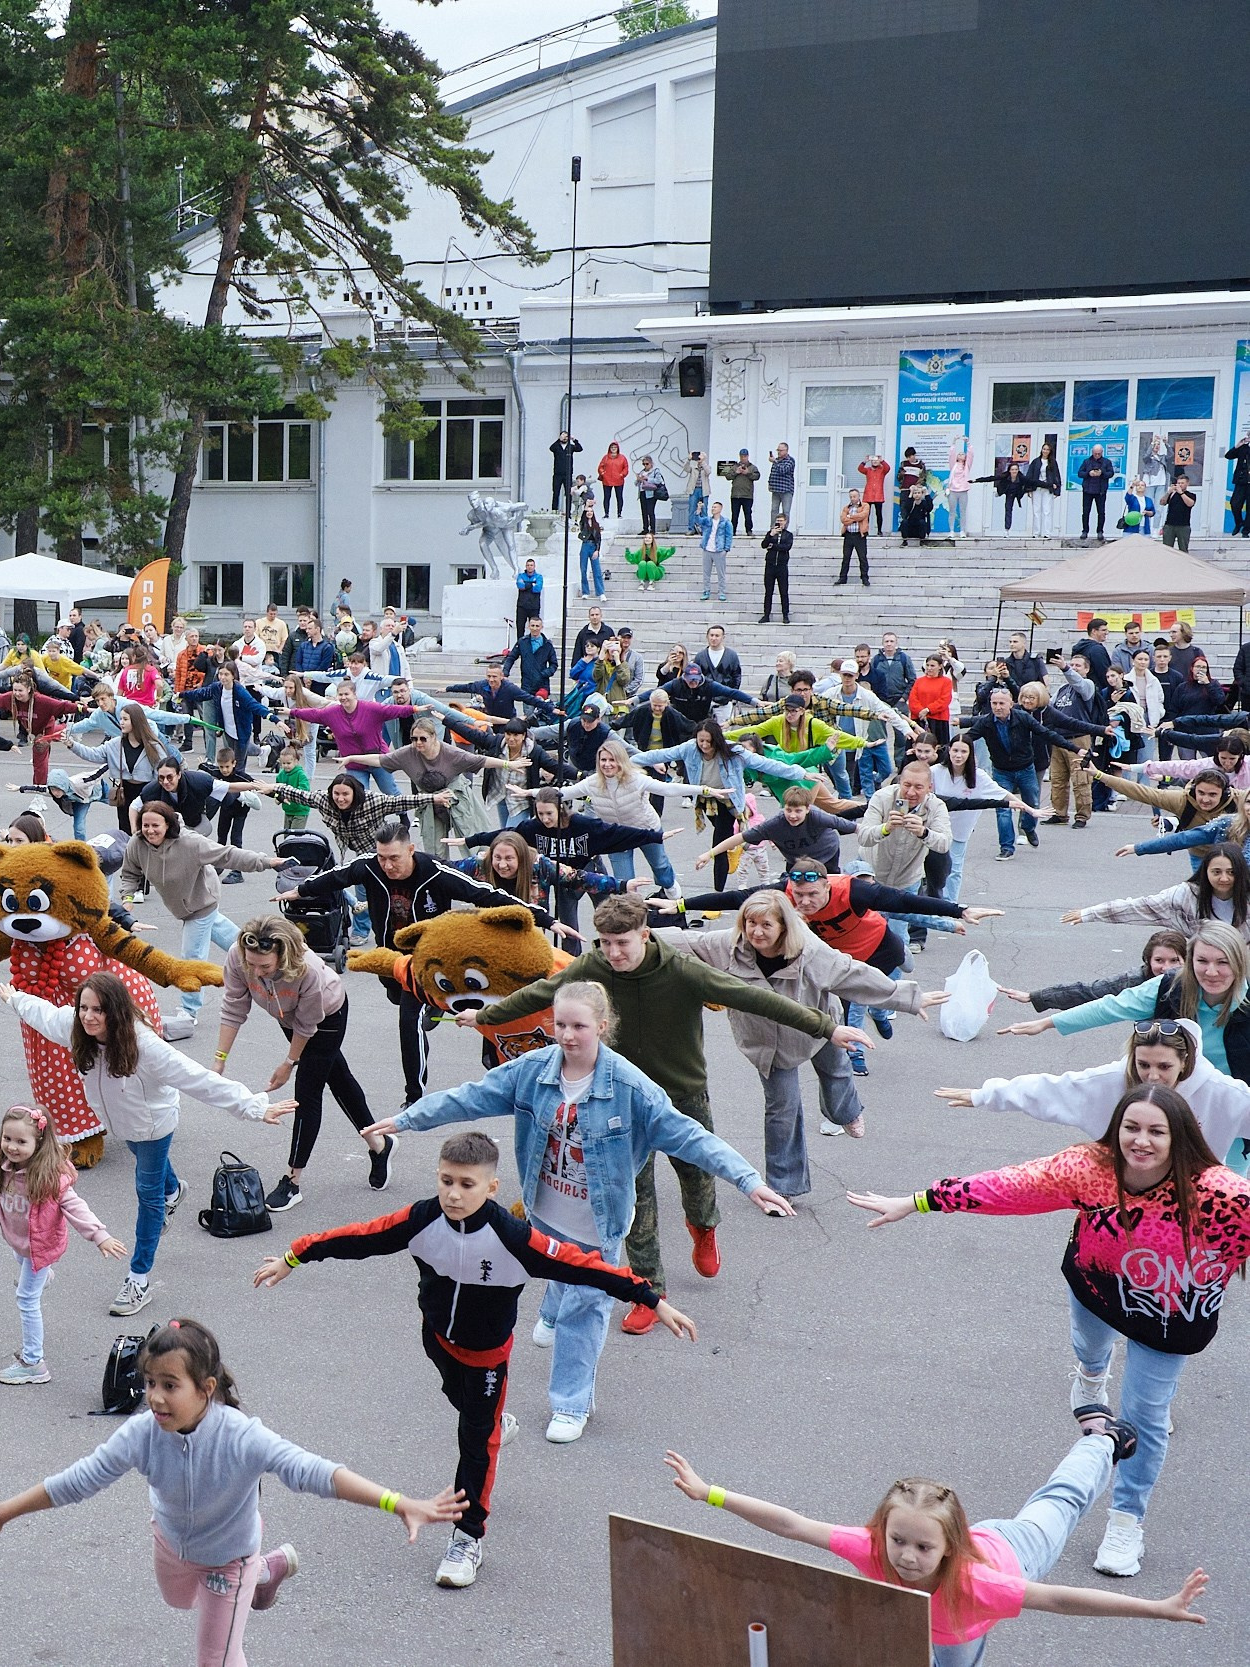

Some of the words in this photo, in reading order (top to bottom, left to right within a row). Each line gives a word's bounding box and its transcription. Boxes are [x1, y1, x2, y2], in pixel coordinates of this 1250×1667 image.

[904, 412, 929, 422] 09.00
[936, 411, 961, 421] 22.00
[141, 580, 154, 627] ПРО
[539, 1172, 588, 1200] ADGIRLS
[1120, 1247, 1227, 1293] ONE
